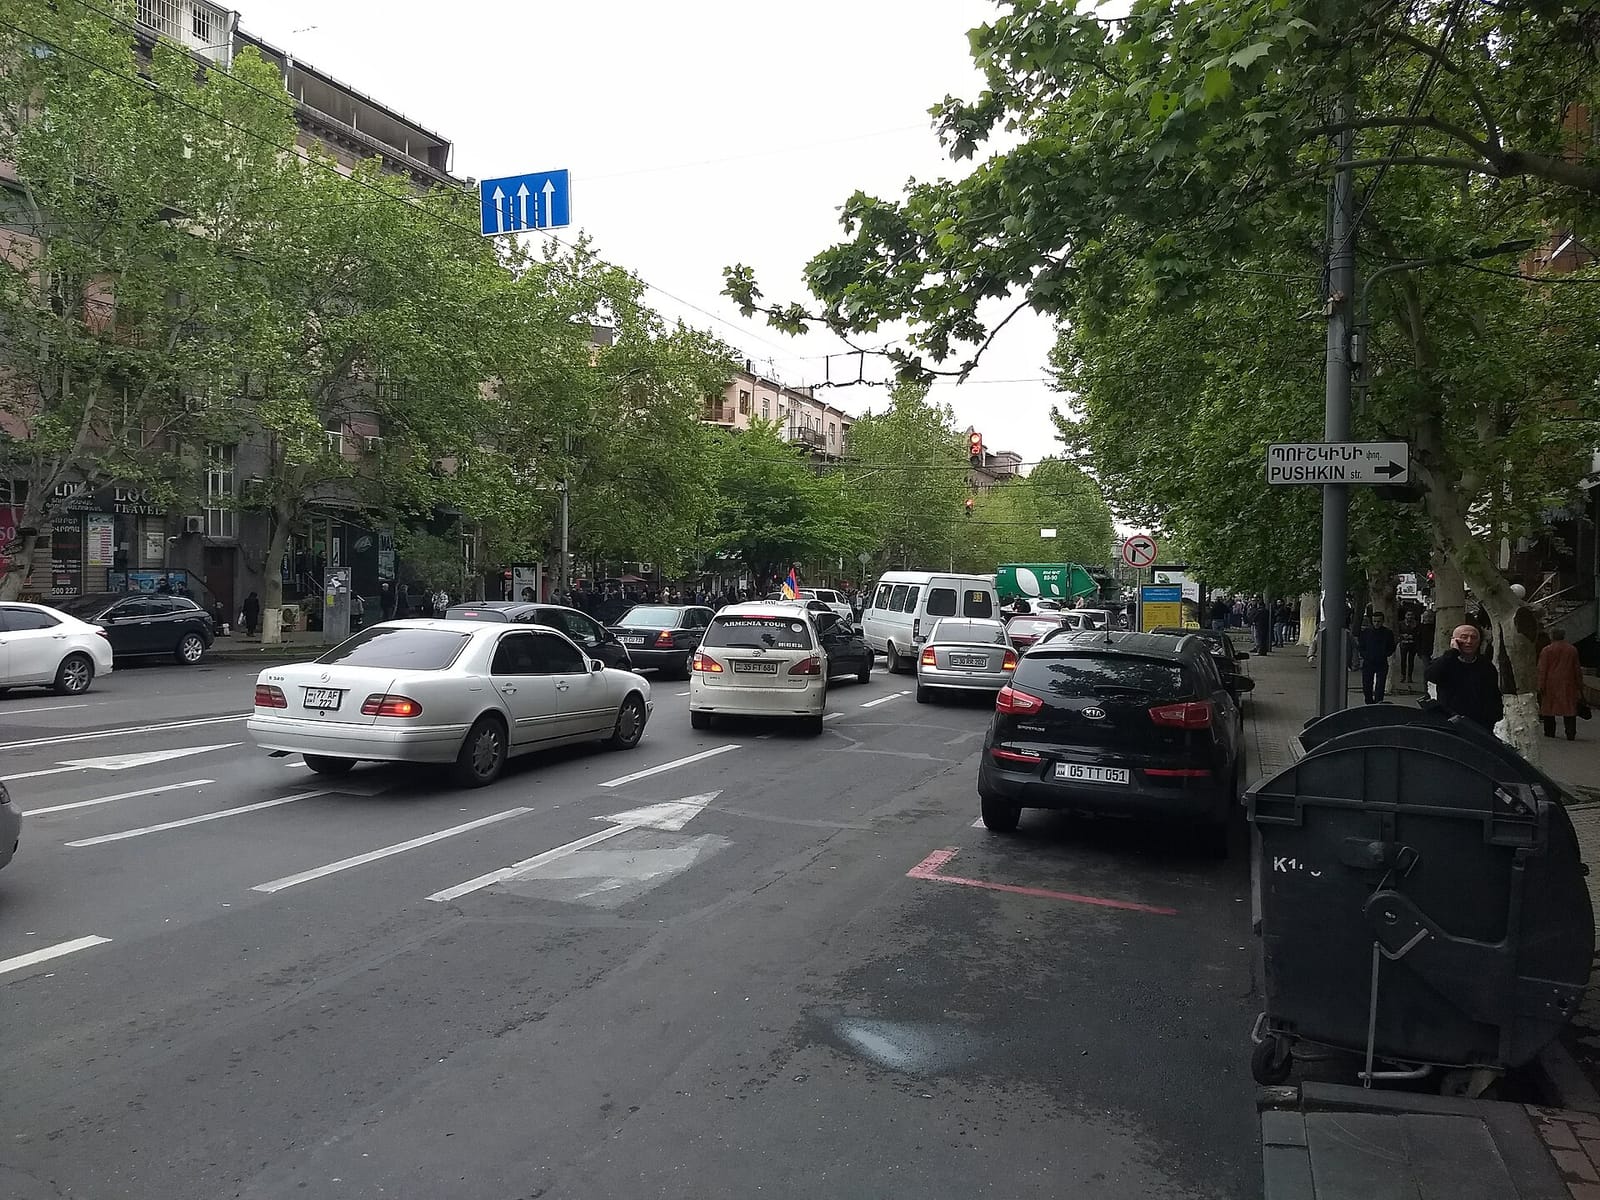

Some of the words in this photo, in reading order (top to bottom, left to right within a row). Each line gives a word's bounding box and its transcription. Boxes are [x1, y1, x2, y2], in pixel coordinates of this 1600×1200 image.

[1271, 446, 1363, 462] ՊՈՒՇԿԻՆԻ
[1271, 465, 1345, 480] PUSHKIN
[1350, 469, 1362, 479] str.
[722, 620, 762, 628] ARMENIA
[1085, 708, 1102, 718] KIA
[1070, 765, 1083, 777] 05
[1087, 767, 1102, 779] TT
[1105, 769, 1127, 782] 051
